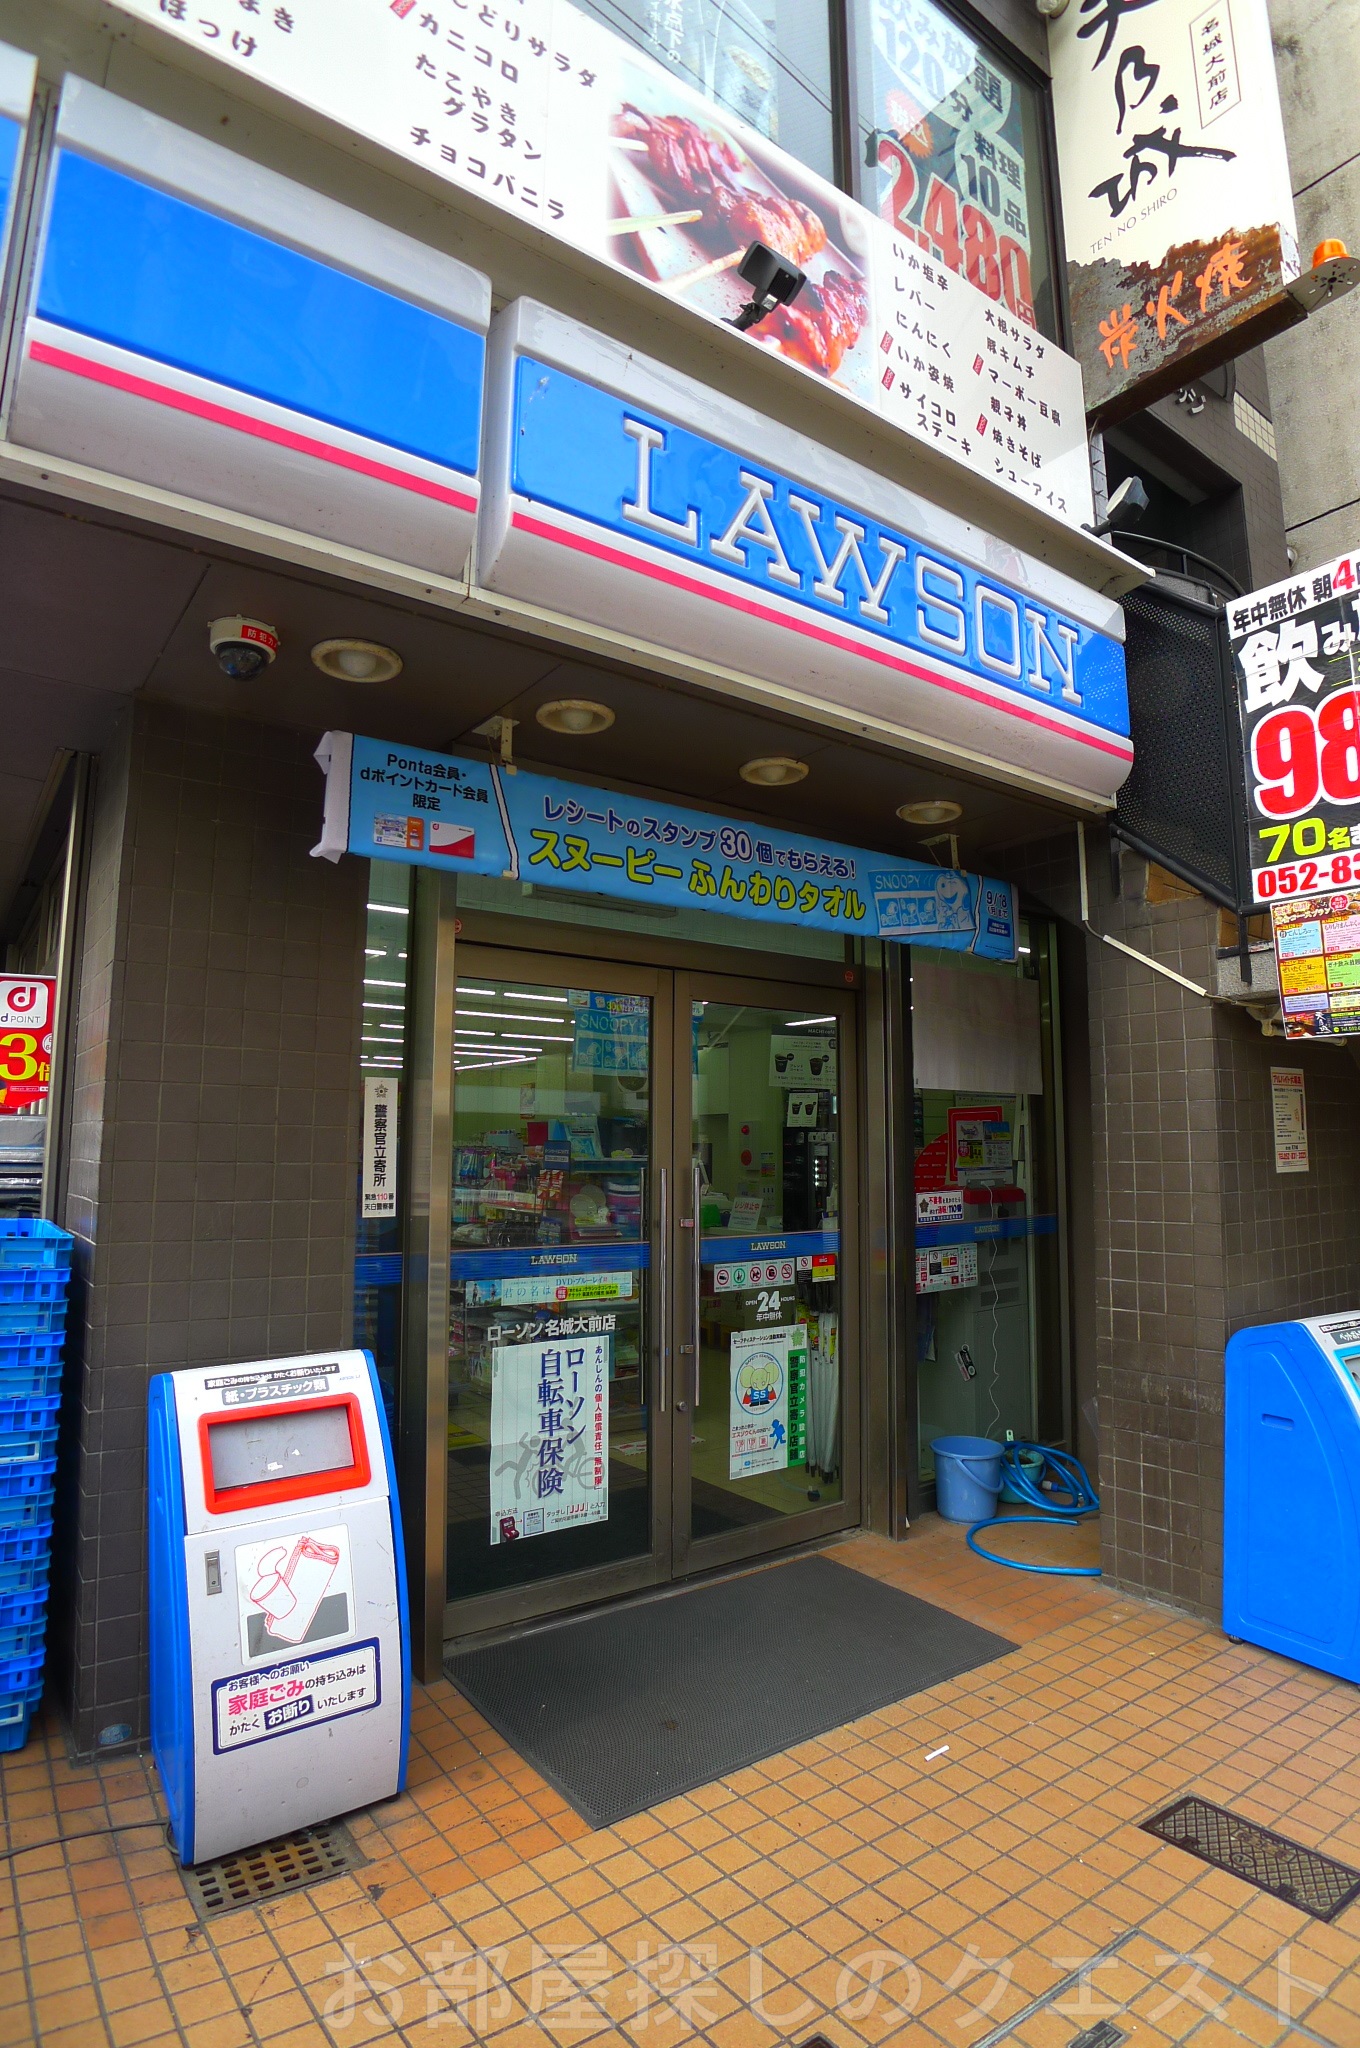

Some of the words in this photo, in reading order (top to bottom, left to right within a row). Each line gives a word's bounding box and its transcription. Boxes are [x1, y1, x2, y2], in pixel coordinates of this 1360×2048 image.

[418, 12, 519, 84] カニコロ
[1200, 19, 1230, 111] 名城大前店
[415, 53, 517, 126] たこやき
[442, 96, 542, 160] グラタン
[409, 125, 565, 220] チョコバニラ
[972, 130, 1022, 191] 料理
[1090, 232, 1113, 255] TEN
[1116, 215, 1137, 238] NO
[1140, 187, 1178, 221] SHIRO
[891, 242, 949, 292] いか塩辛
[894, 275, 936, 311] レバー
[896, 310, 952, 359] にんにく
[984, 308, 1046, 360] 大根サラダ
[986, 336, 1036, 379] 豚キムチ
[897, 346, 955, 394] いか姿焼
[900, 382, 956, 427] サイコロ
[988, 368, 1062, 427] マーボー豆腐
[990, 395, 1027, 432] 親子丼
[917, 413, 972, 456] ステーキ
[992, 426, 1042, 470] 焼きそば
[994, 456, 1068, 514] シューアイス
[620, 417, 1083, 706] LAWSON
[1232, 584, 1308, 634] 年中無休
[1312, 557, 1360, 603] 朝4
[1237, 594, 1360, 714] 飲み
[360, 767, 489, 804] dポイントカード会員
[412, 793, 442, 812] 限定
[874, 874, 921, 892] SNOOPY
[1, 1014, 9, 1023] d
[10, 1015, 41, 1024] POINT
[579, 1008, 638, 1033] SNOOPY
[373, 1103, 389, 1188] 警察官立寄所
[364, 1202, 395, 1212] 天白警察署
[530, 1253, 578, 1266] LAWSON
[750, 1240, 787, 1251] LAWSON
[755, 1311, 783, 1322] 年中無休
[757, 1290, 781, 1313] 24
[224, 1378, 328, 1404] 紙・プラスチック類
[566, 1347, 587, 1446] ローソン
[753, 1390, 767, 1400] SS
[537, 1348, 565, 1500] 自転車保険
[228, 1660, 311, 1692] お客様へのお願い
[228, 1664, 367, 1716] 家庭ごみの持ち込みは
